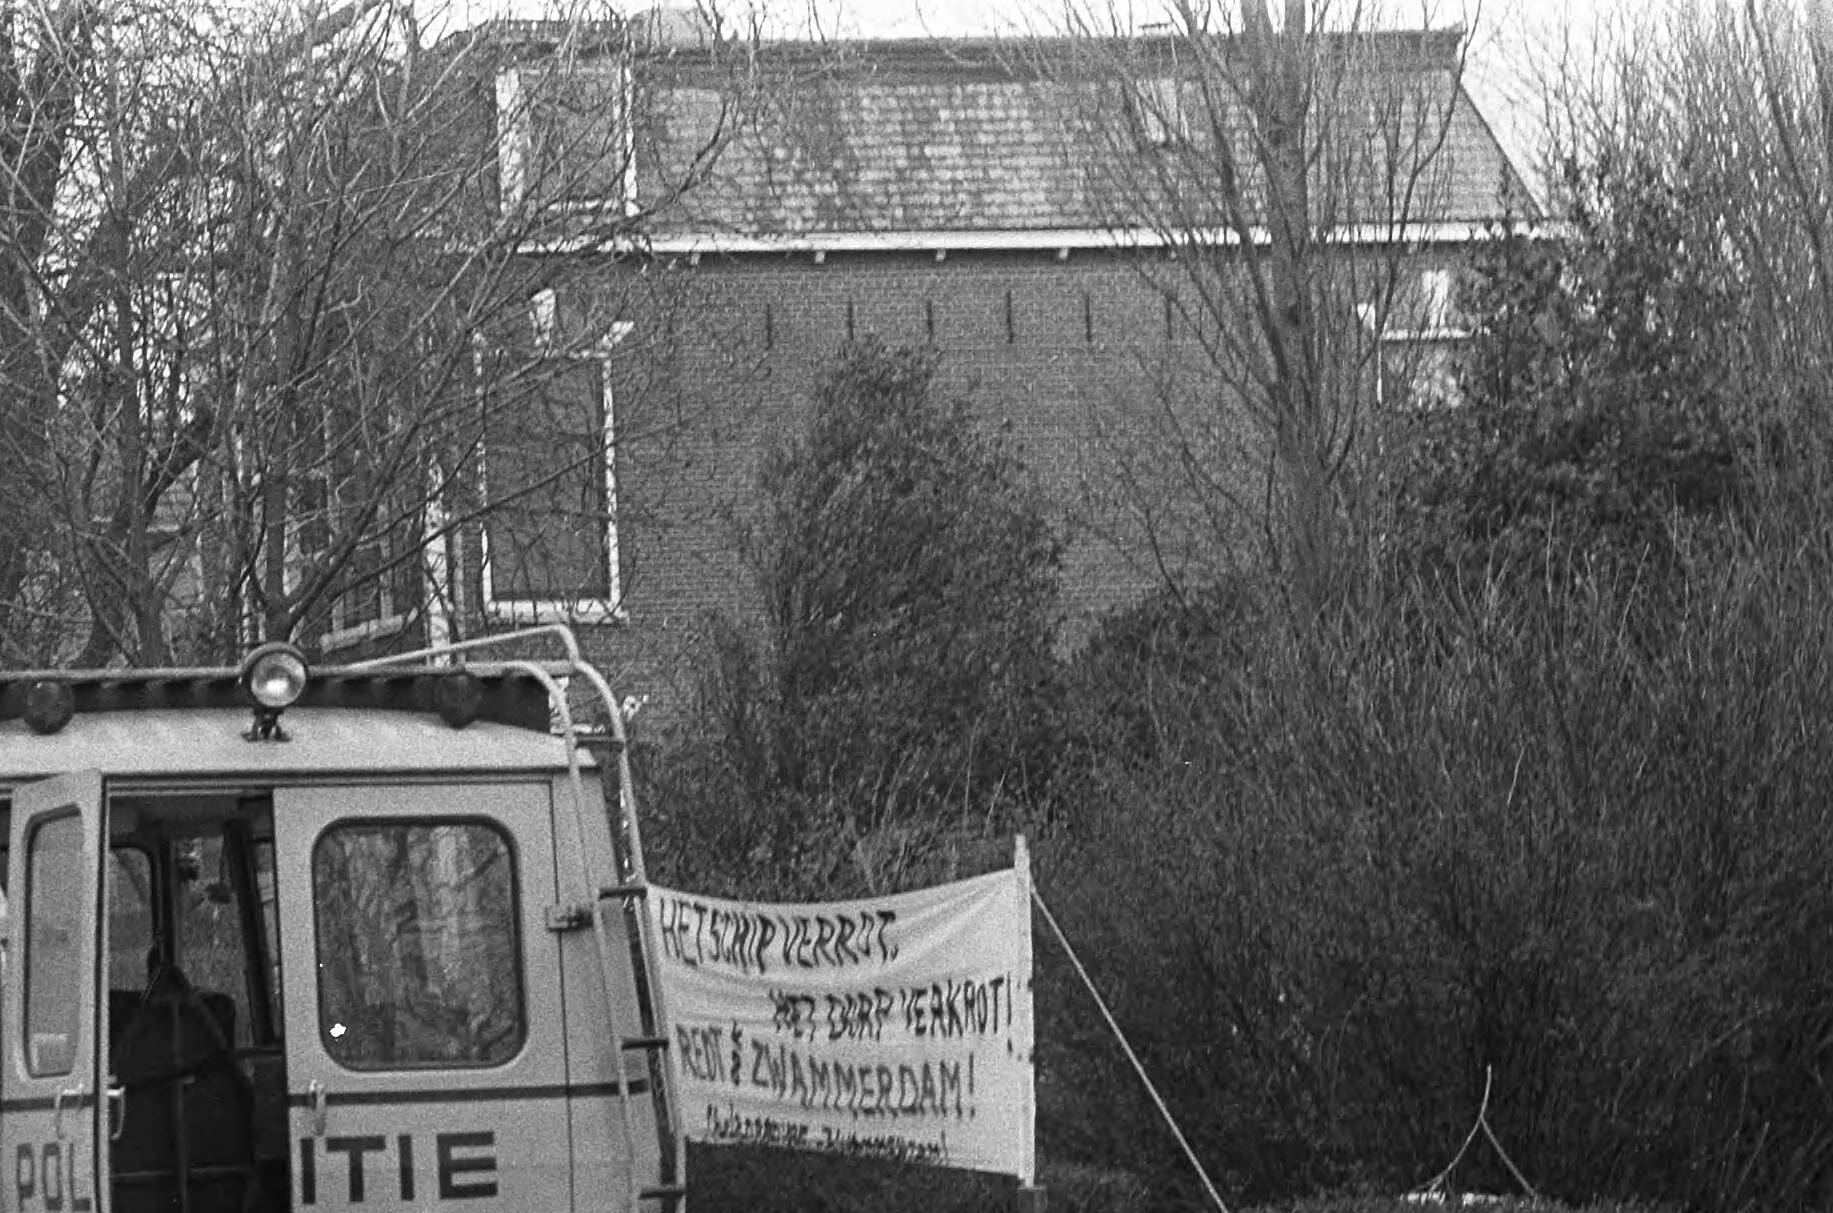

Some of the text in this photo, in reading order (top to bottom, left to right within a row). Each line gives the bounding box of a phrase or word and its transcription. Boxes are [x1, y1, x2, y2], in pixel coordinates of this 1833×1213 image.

[660, 897, 707, 968] HET
[709, 907, 776, 975] SCHIP
[15, 1131, 499, 1213] POL ITIE
